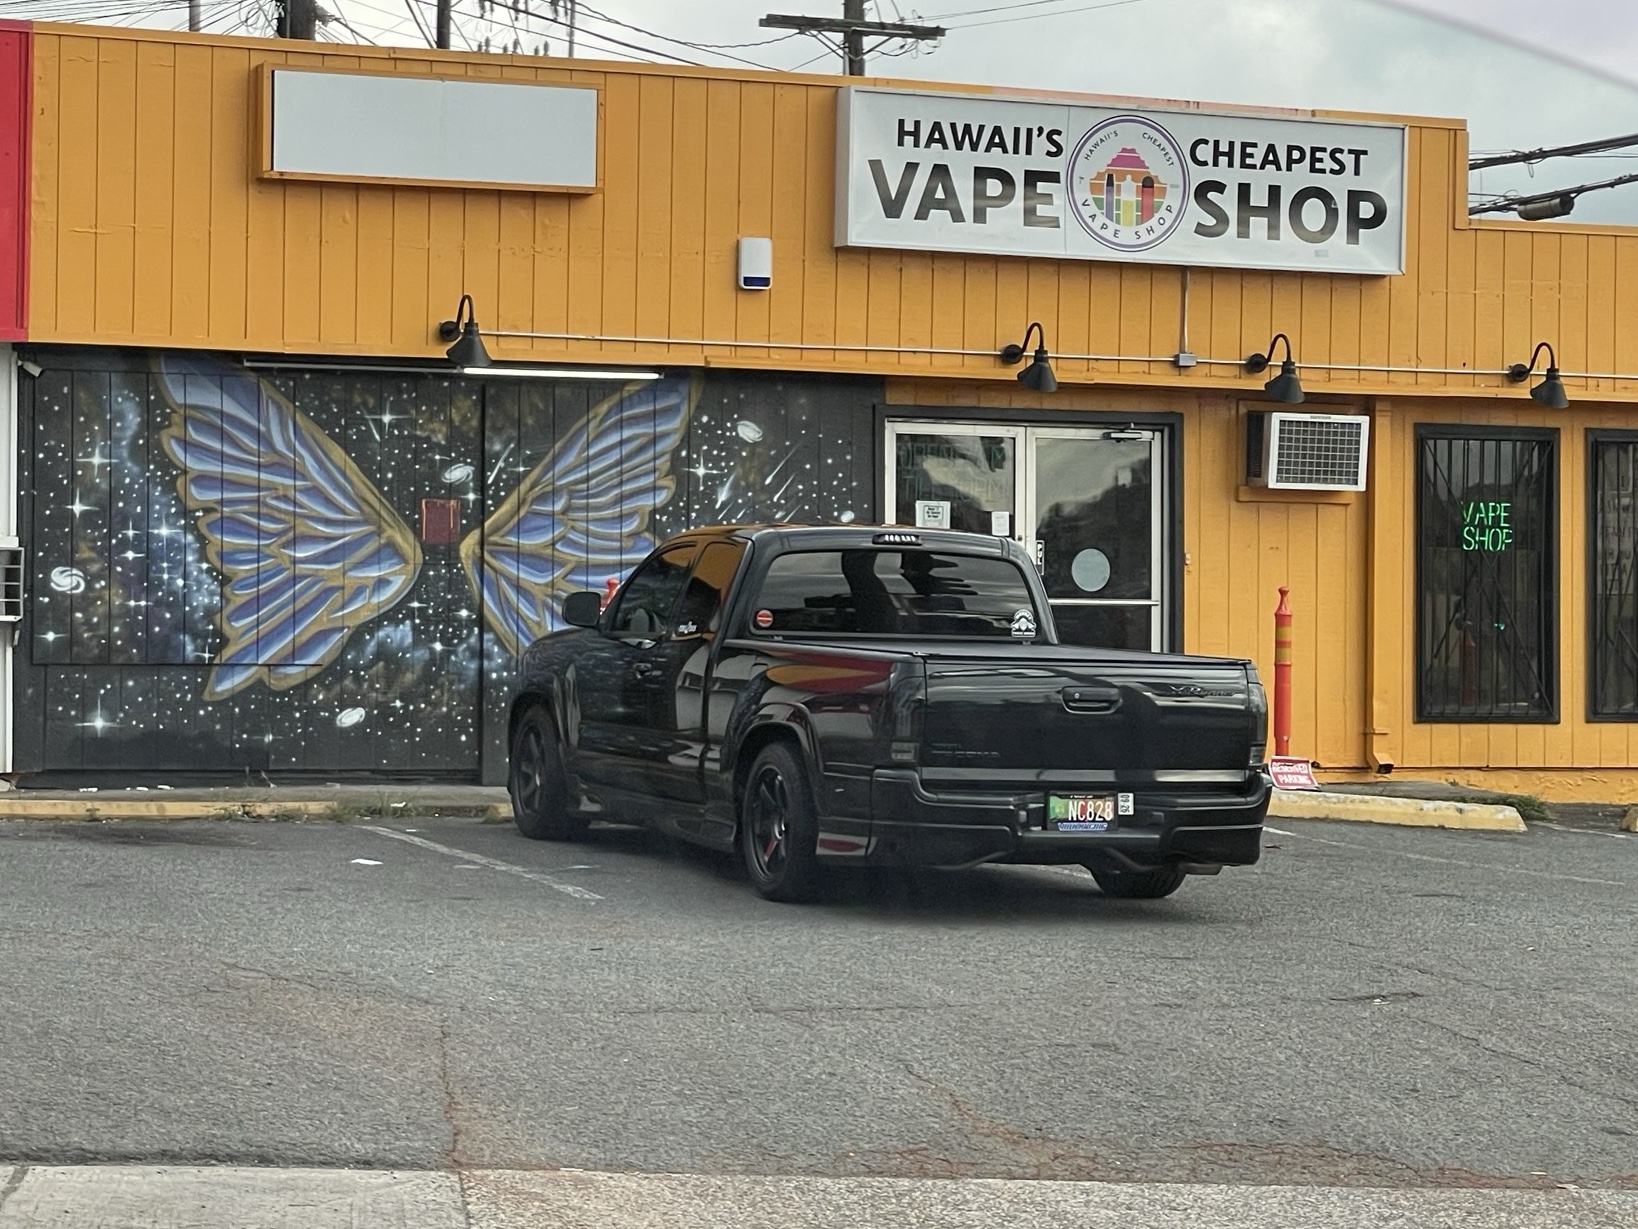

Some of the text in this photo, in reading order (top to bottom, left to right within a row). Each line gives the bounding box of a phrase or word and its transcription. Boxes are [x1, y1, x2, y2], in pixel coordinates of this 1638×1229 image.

[897, 118, 1369, 177] HAWAII'S CHEAPEST
[1142, 132, 1175, 167] CHEAPEST
[867, 158, 1388, 246] VAPE SHOP
[1081, 198, 1174, 240] VAPE SHOP
[1462, 501, 1512, 527] VAPE
[1462, 526, 1513, 552] SHOP
[1067, 799, 1114, 822] NC828
